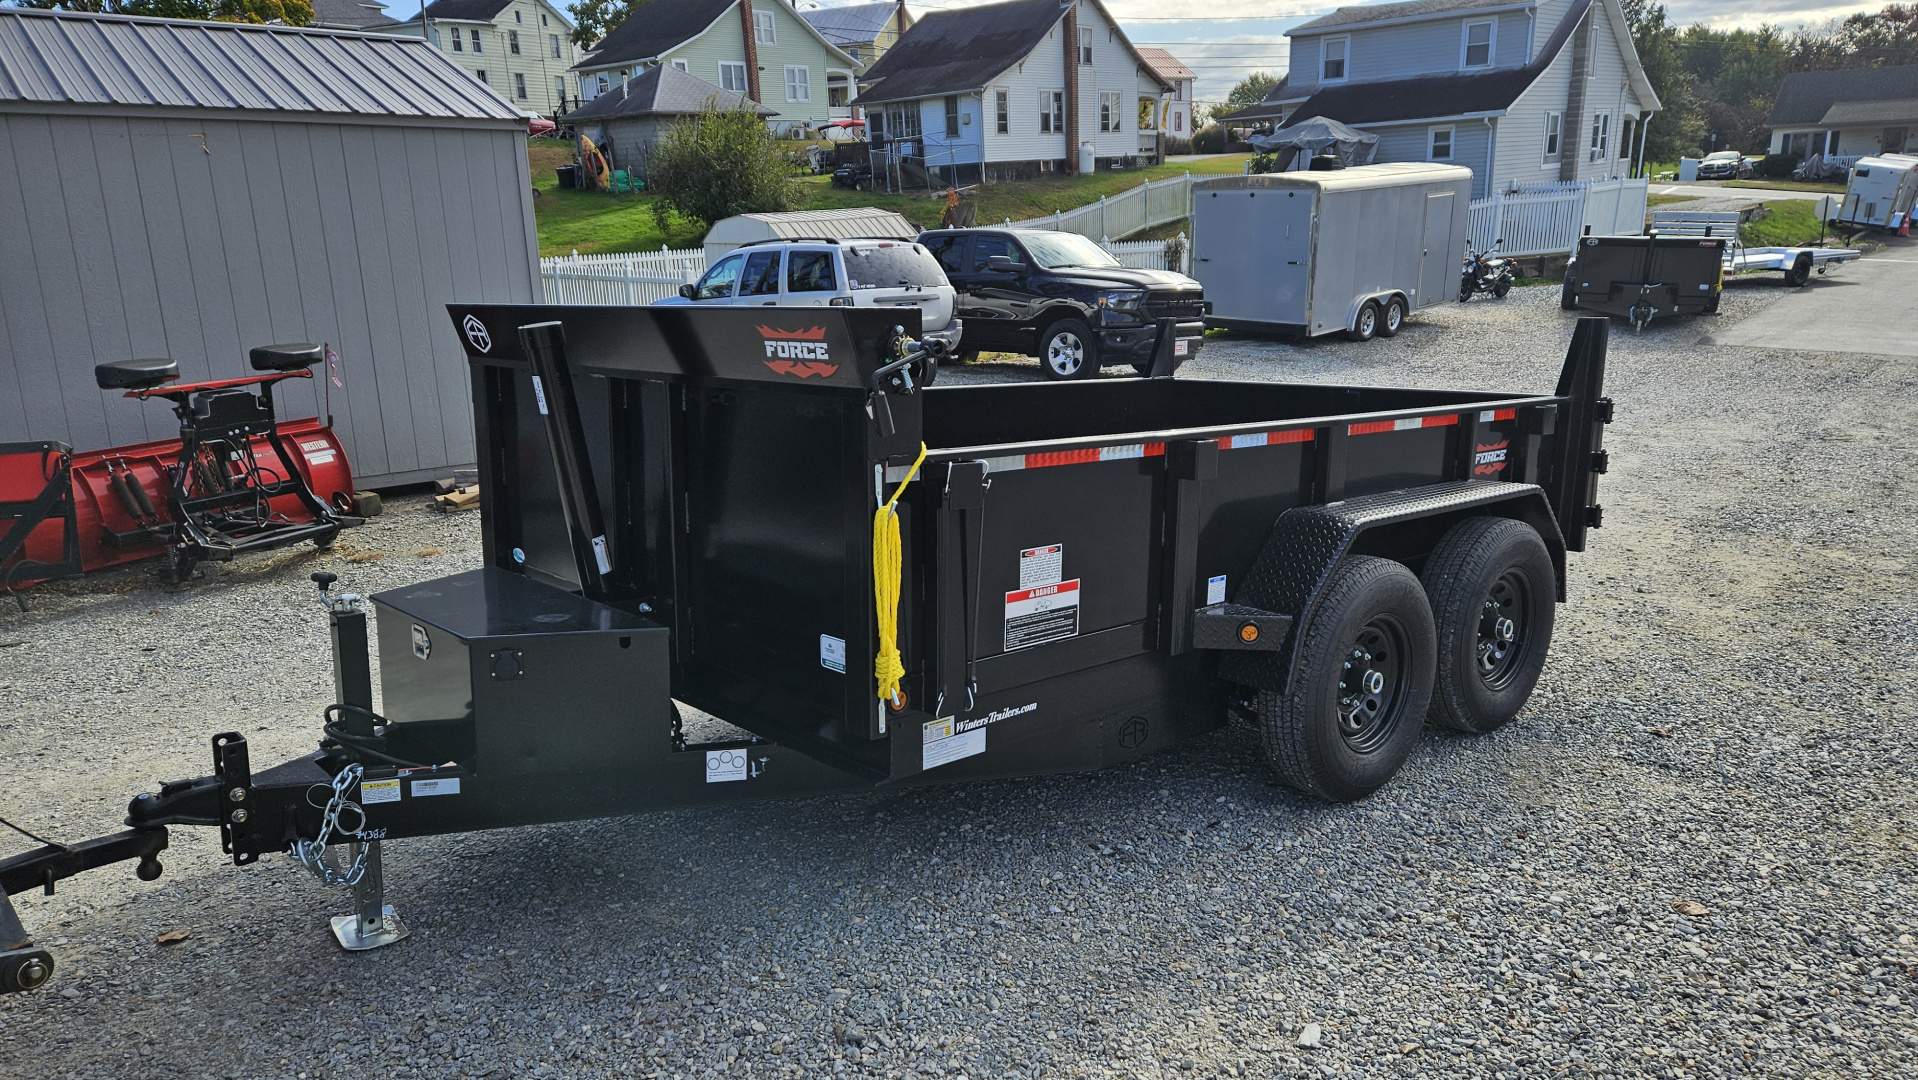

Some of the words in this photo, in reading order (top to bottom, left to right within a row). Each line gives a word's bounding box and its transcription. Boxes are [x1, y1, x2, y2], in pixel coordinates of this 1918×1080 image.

[764, 340, 829, 360] FORCE
[1475, 449, 1507, 464] FORCE
[1035, 585, 1058, 597] DANGER
[956, 702, 1038, 733] WintersTrailers.com
